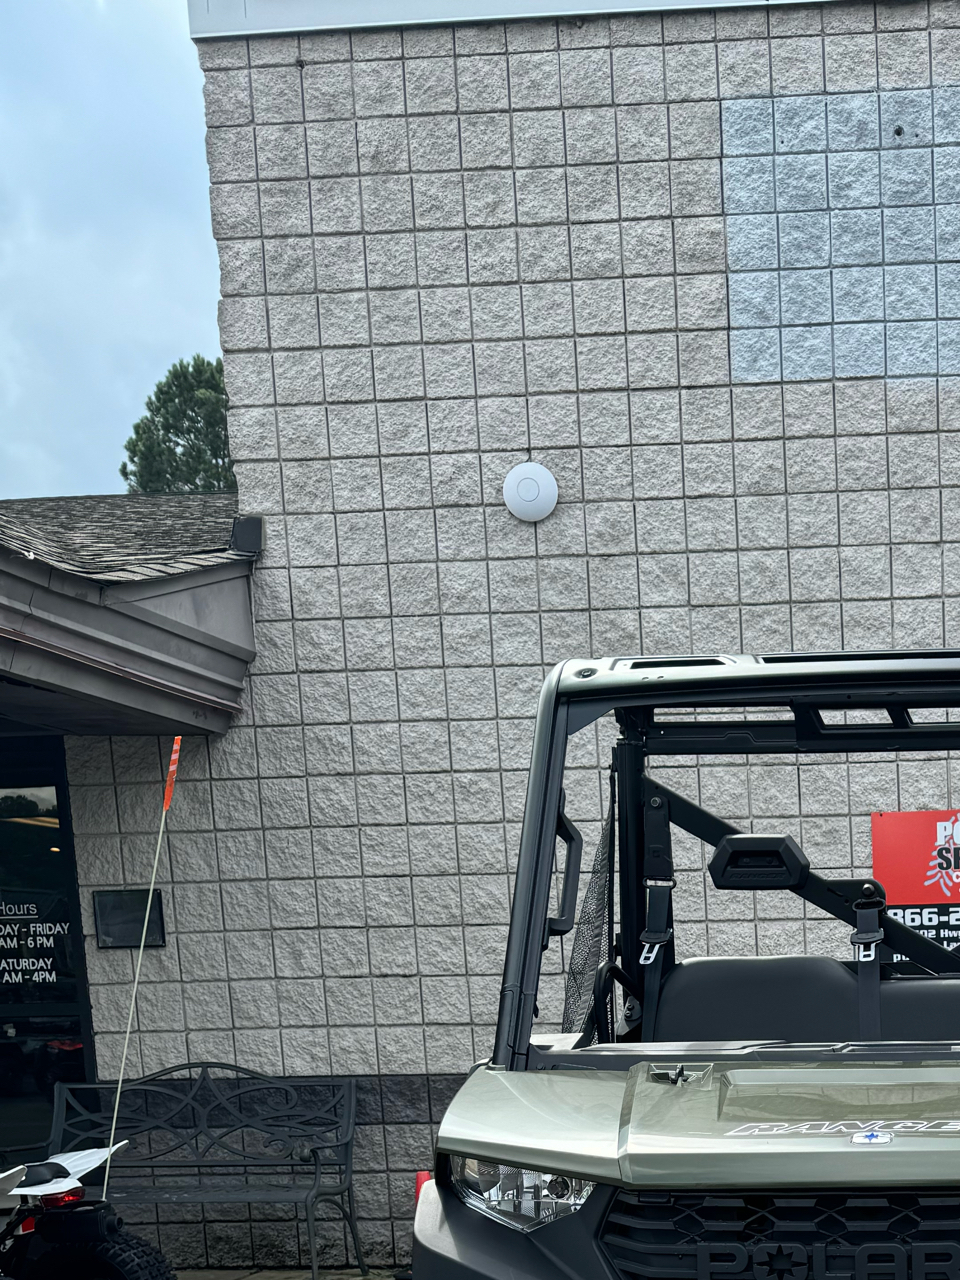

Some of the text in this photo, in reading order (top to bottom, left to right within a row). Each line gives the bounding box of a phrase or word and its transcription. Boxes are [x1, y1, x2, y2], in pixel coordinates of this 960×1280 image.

[30, 923, 70, 935] FRIDAY
[914, 929, 937, 938] 02
[27, 936, 35, 948] 6
[36, 936, 54, 948] PM
[2, 971, 23, 984] AM
[32, 971, 56, 983] 4PM
